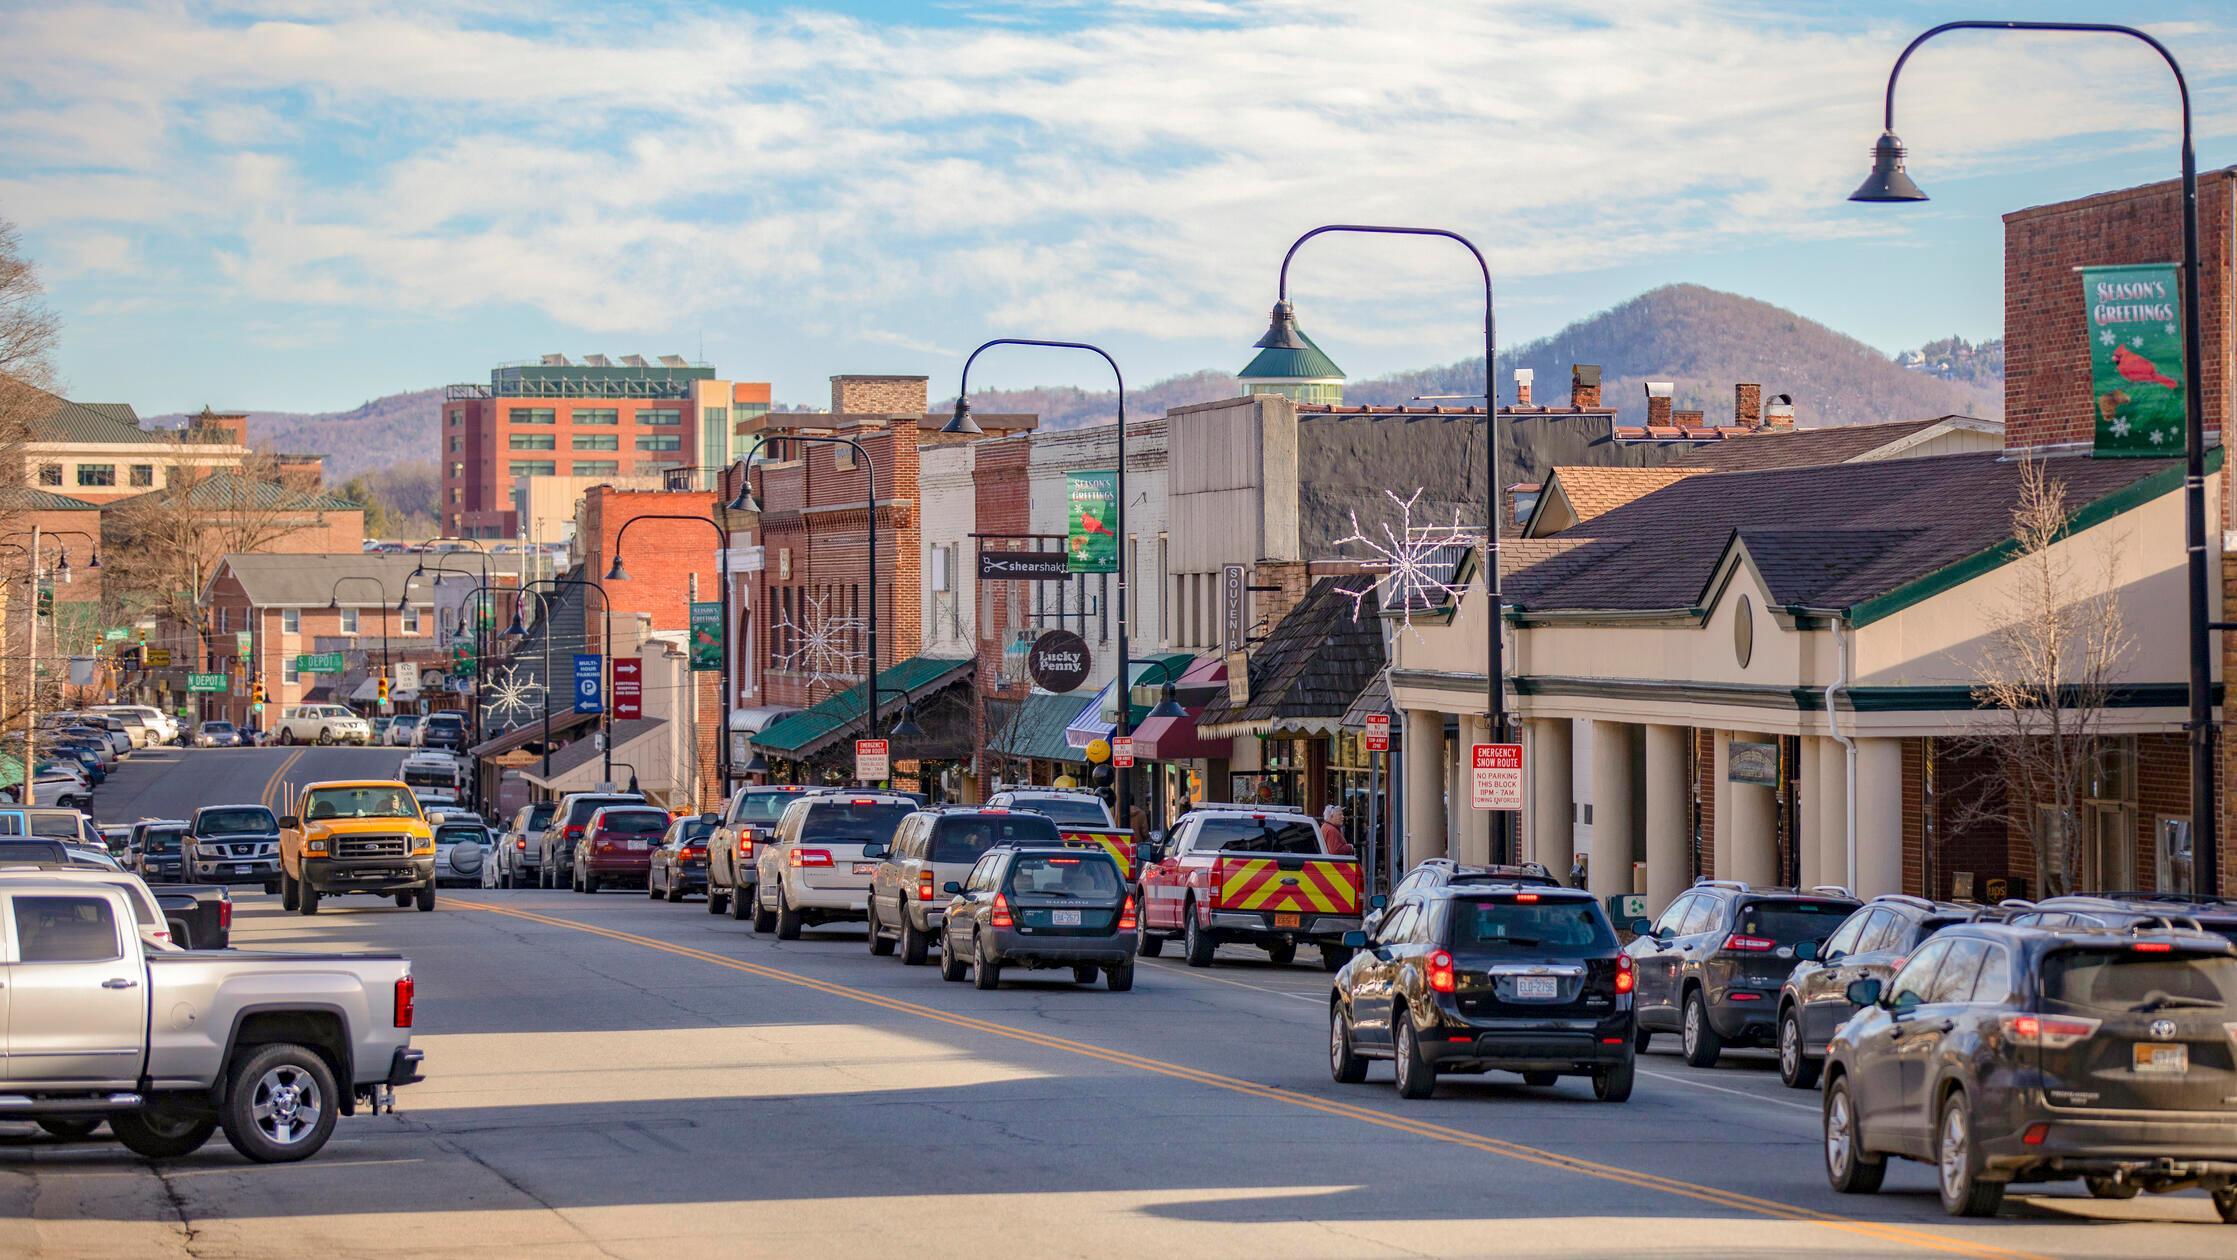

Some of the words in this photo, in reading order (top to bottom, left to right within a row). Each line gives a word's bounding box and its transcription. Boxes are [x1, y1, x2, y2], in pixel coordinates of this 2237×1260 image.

[2096, 281, 2165, 303] SEASON'S
[2094, 304, 2174, 325] GREETINGS
[1074, 479, 1112, 490] SEASON'S
[1072, 490, 1114, 501] GREETINGS
[308, 656, 333, 667] DEPOT
[1039, 651, 1081, 662] Lucky
[401, 663, 412, 672] NO
[1040, 661, 1082, 672] Penny.
[188, 675, 193, 684] N
[195, 675, 218, 686] DEPOT
[1478, 748, 1517, 757] EMERGENCY
[1477, 758, 1496, 767] SNOW
[1497, 758, 1518, 767] ROUTE
[1989, 886, 2004, 900] ups
